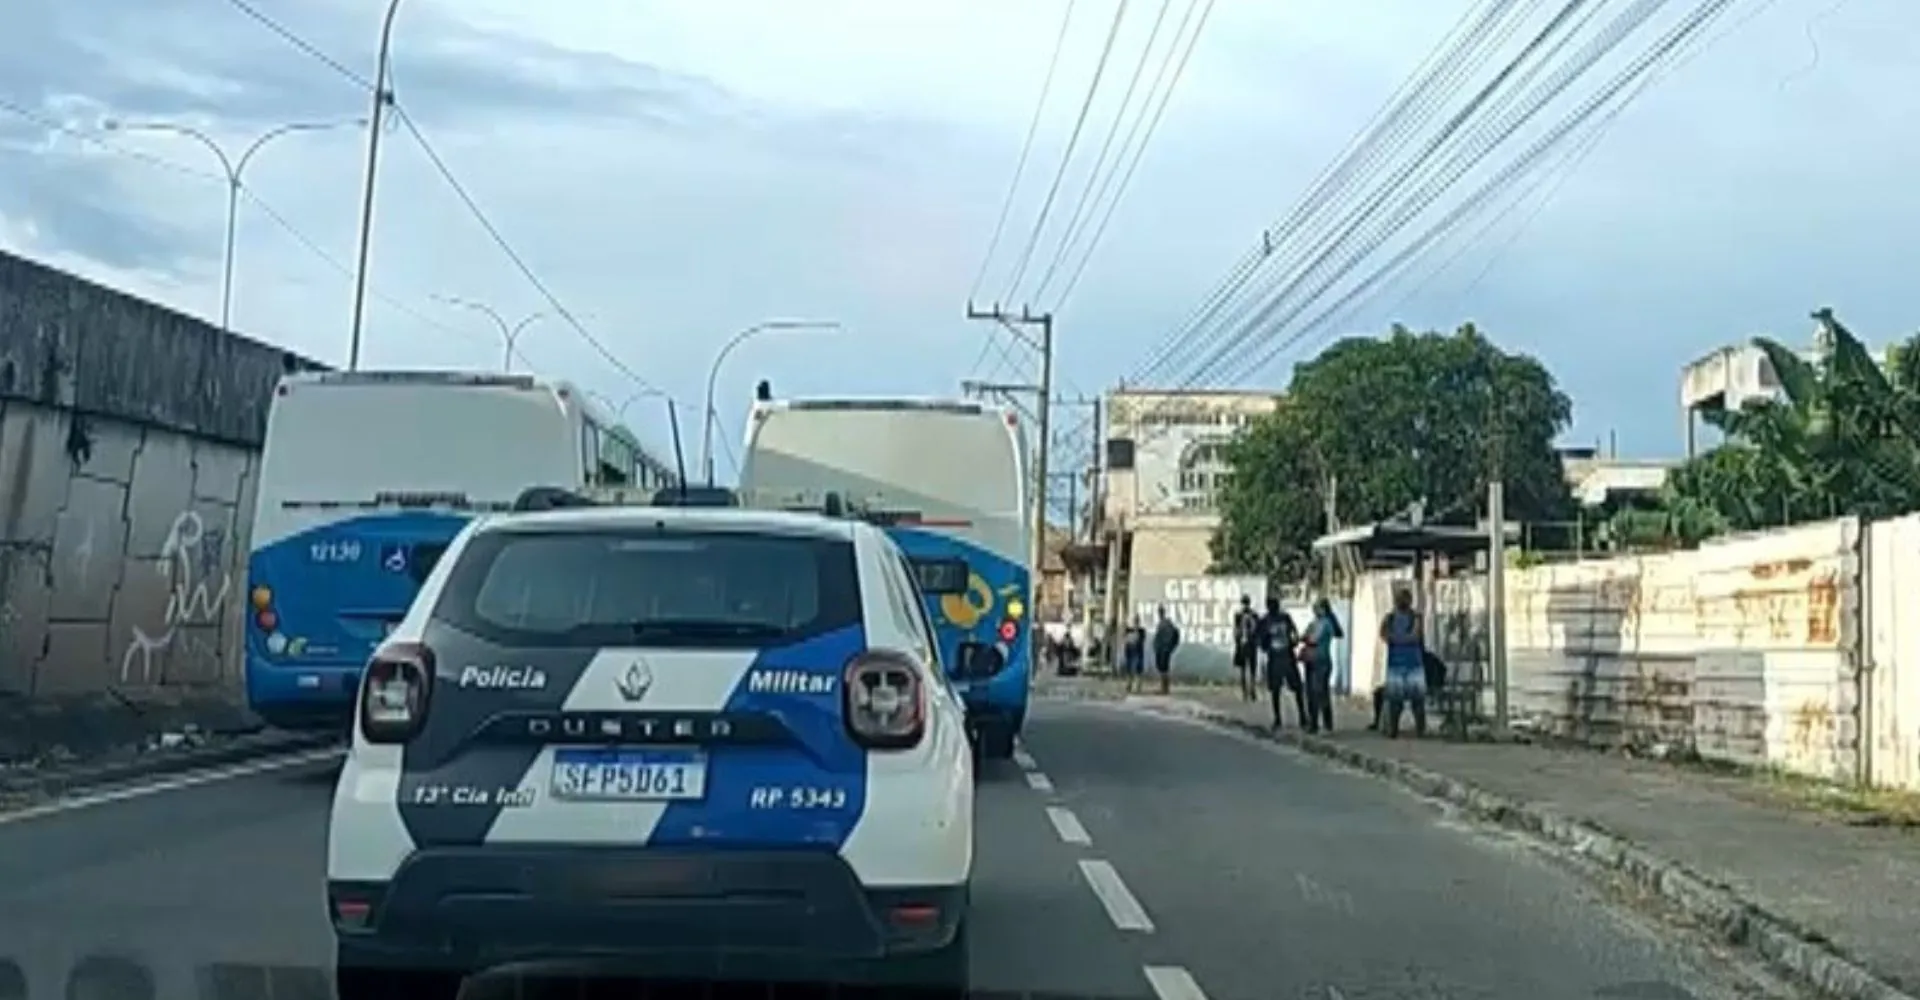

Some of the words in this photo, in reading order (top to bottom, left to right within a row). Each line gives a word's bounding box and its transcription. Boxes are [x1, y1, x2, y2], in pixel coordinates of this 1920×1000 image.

[750, 670, 835, 692] Militar
[528, 718, 732, 736] DUSTER
[452, 786, 488, 804] Cia
[751, 788, 783, 809] RP
[790, 788, 846, 809] 5343
